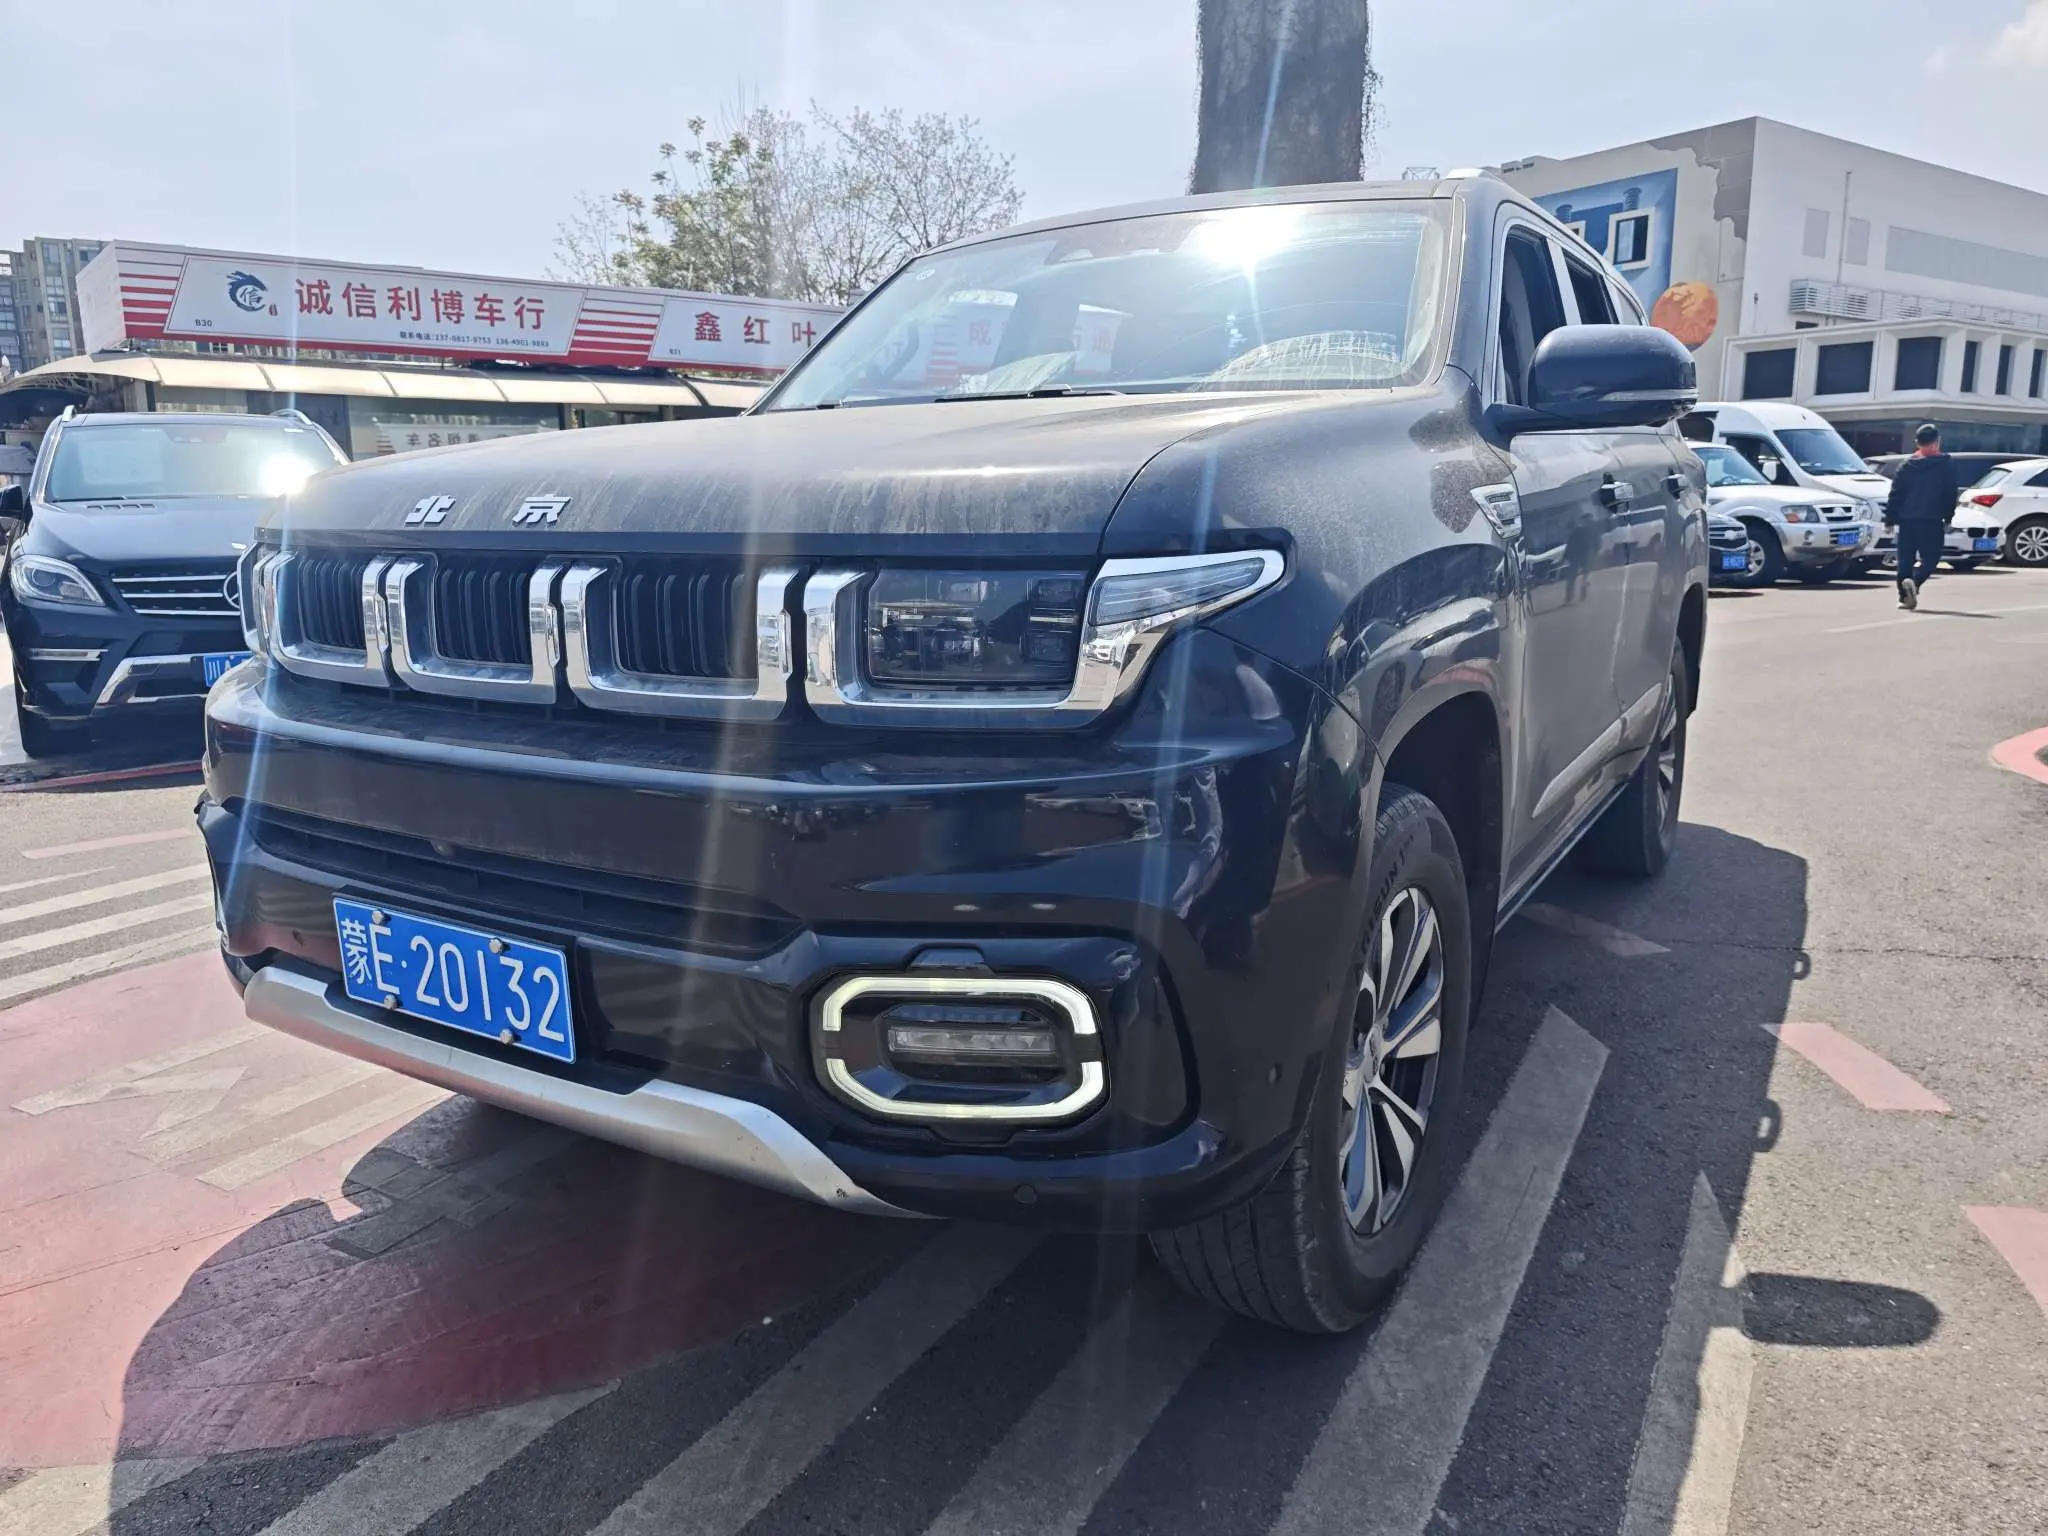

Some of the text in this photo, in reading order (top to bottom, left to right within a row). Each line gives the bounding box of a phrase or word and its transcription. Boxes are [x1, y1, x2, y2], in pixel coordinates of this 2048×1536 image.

[295, 278, 545, 330] 诚信利博车行
[695, 311, 817, 348] 鑫红叶
[404, 494, 573, 526] 北京
